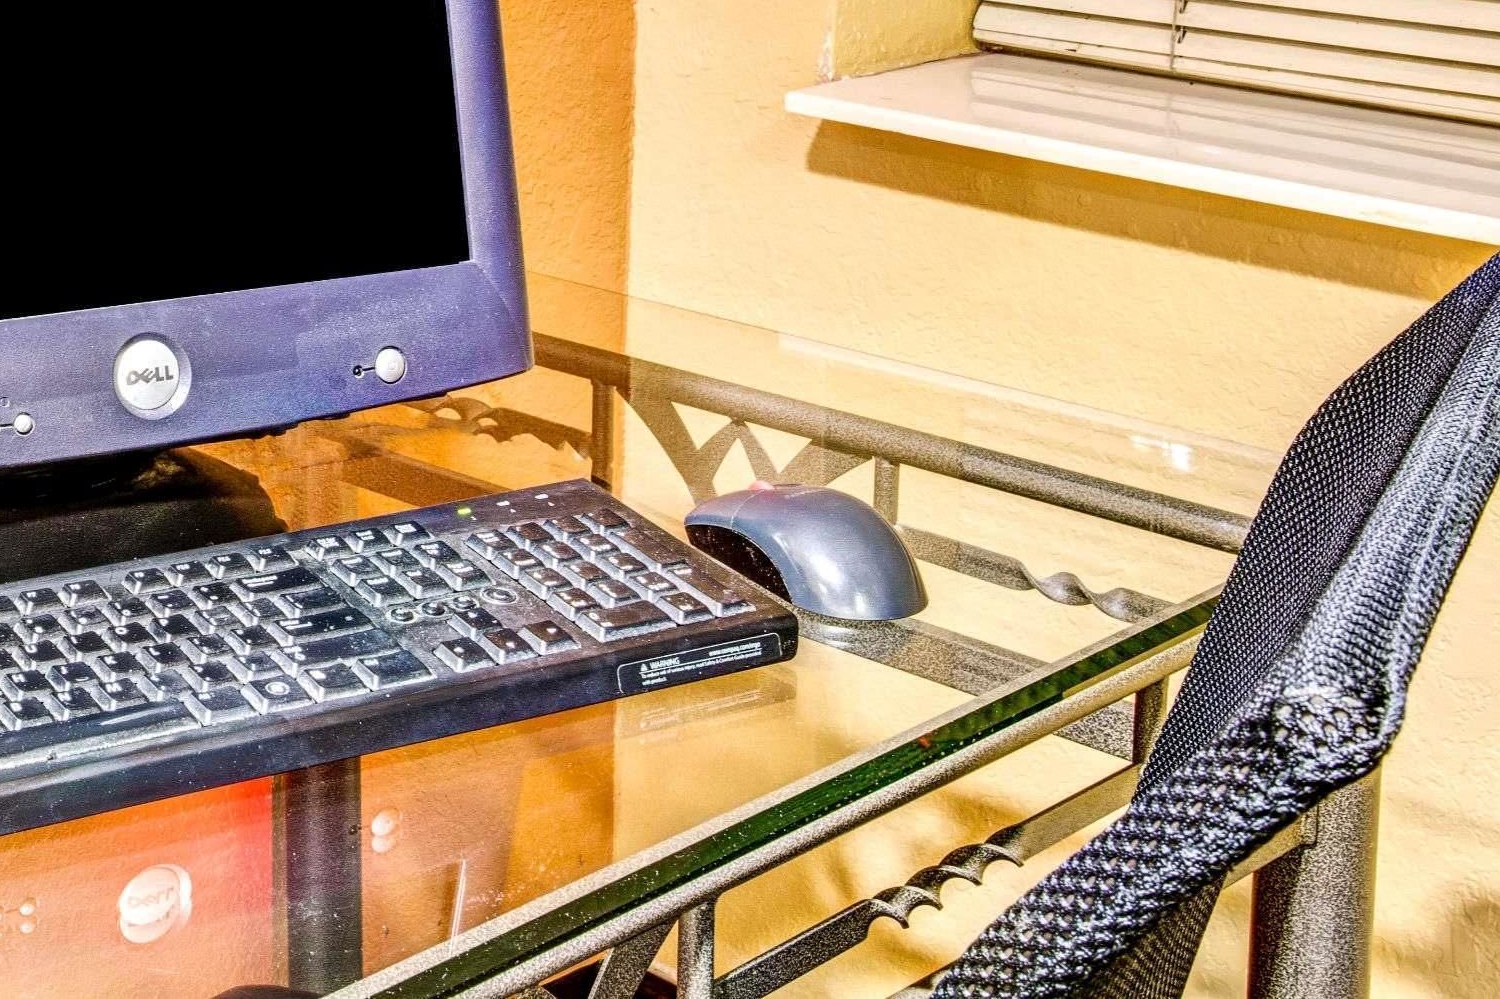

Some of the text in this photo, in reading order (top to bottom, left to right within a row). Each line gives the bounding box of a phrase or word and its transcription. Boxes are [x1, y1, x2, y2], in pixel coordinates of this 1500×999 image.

[126, 365, 174, 386] DELL
[25, 644, 37, 653] U
[114, 626, 128, 635] O
[11, 673, 26, 683] H
[103, 655, 117, 665] K
[650, 657, 680, 670] WARNING
[57, 692, 72, 703] N
[105, 682, 122, 692] M
